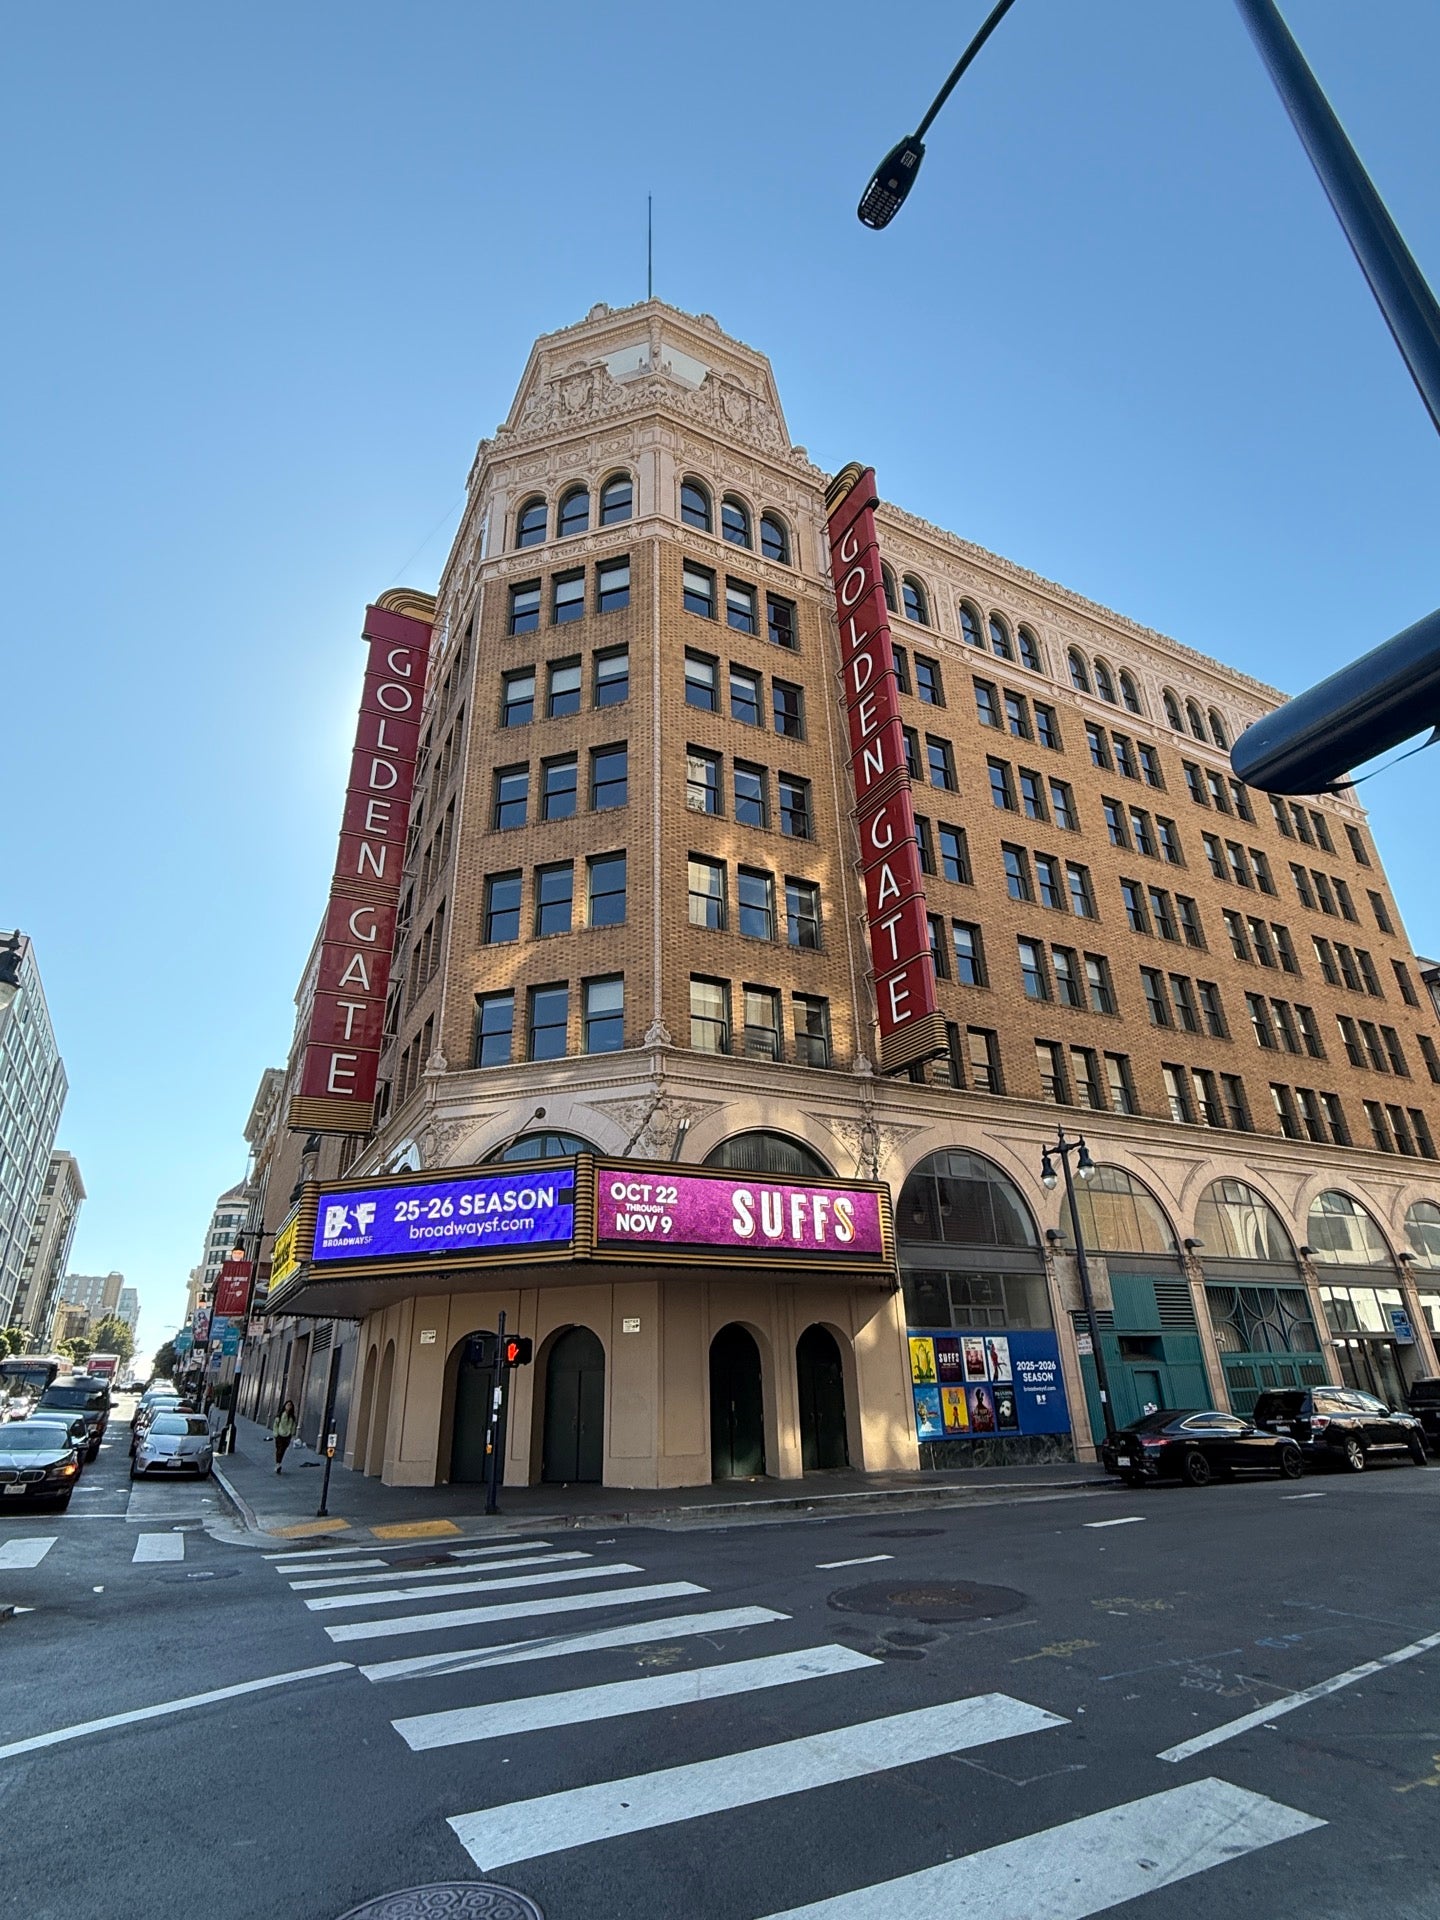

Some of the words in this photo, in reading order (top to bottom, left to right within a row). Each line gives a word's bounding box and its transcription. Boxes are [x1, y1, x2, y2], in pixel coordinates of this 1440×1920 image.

[356, 648, 413, 879] GOLDEN
[841, 527, 885, 785] GOLDEN
[871, 807, 912, 1024] GATE
[327, 906, 377, 1095] GATE
[394, 1196, 455, 1222] 25-26
[458, 1186, 554, 1216] SEASON
[610, 1182, 653, 1202] OCT
[655, 1185, 678, 1204] 22
[625, 1202, 664, 1214] THROUGH
[731, 1188, 856, 1244] SUFFS
[409, 1216, 535, 1239] broadwaysf.com
[616, 1212, 658, 1233] NOV
[660, 1216, 673, 1234] 9
[322, 1235, 374, 1248] BROADWAYSF
[938, 1352, 960, 1363] SUFFS
[1016, 1360, 1057, 1371] 2025-2026
[1022, 1372, 1054, 1382] SEASON
